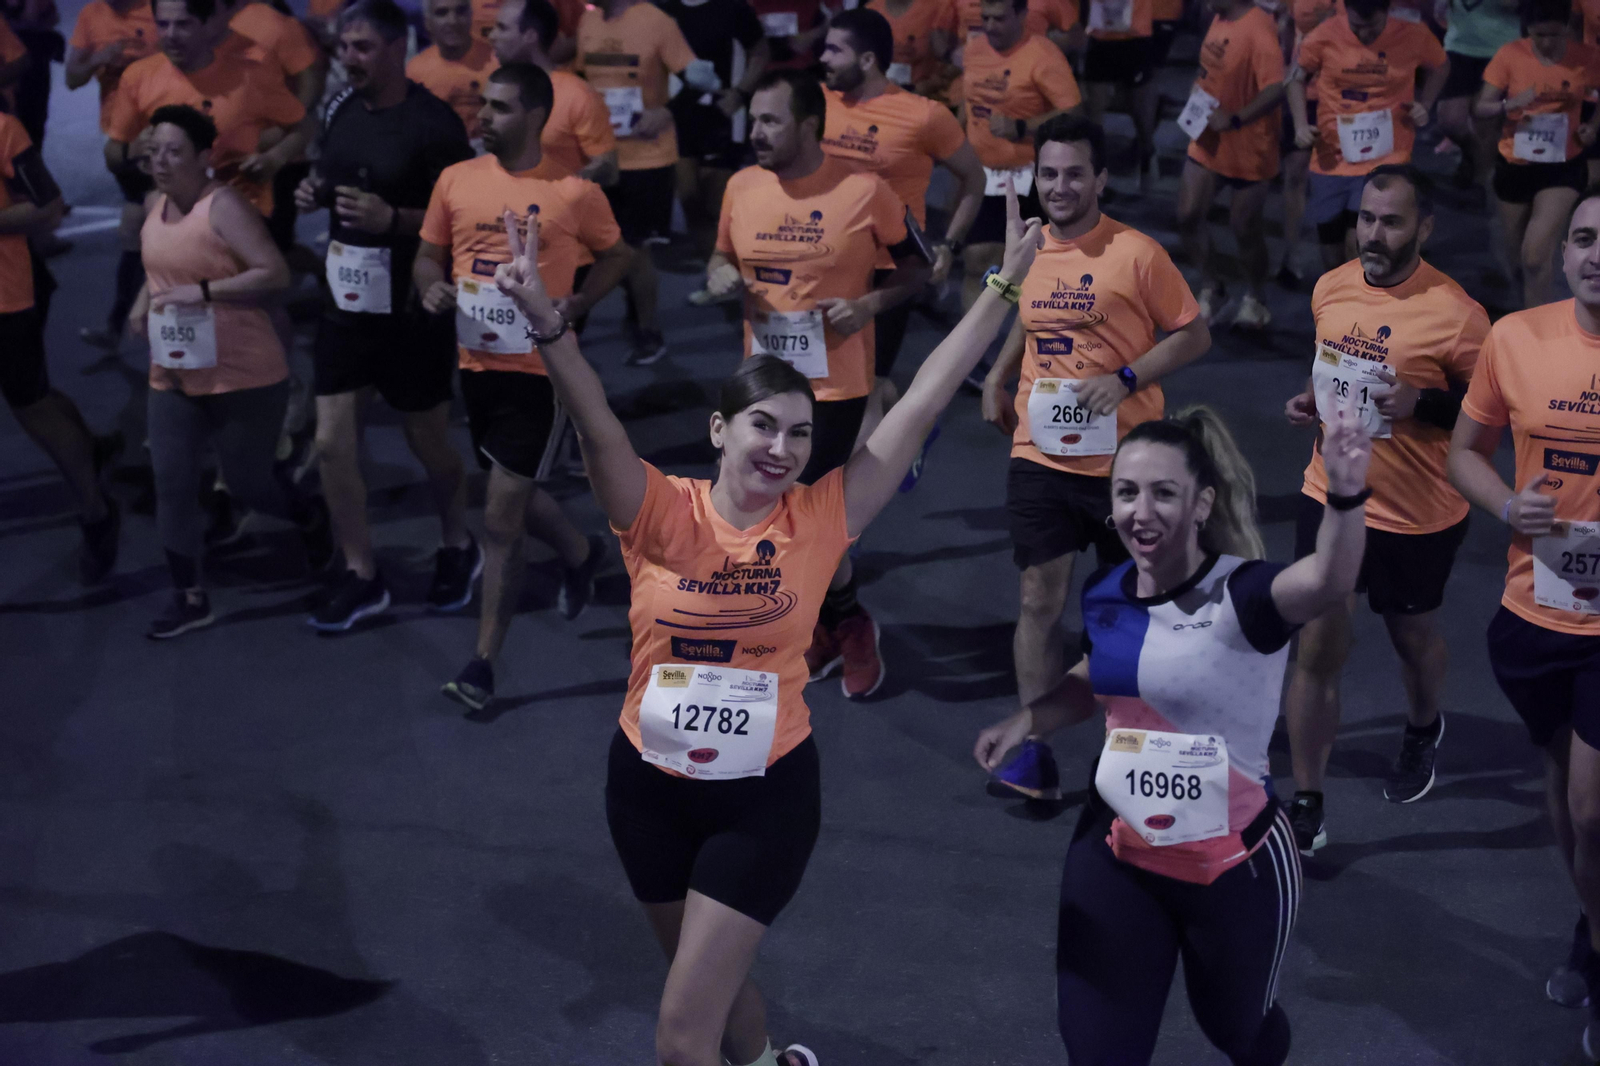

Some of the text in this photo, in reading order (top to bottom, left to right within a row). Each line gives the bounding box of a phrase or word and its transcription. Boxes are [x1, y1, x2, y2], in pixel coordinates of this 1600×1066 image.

[1031, 300, 1069, 310] SEVILLA
[1051, 291, 1096, 301] NOCTURNA
[471, 305, 515, 325] 11489
[763, 334, 809, 351] 10779
[1322, 338, 1360, 358] SEVILLA
[1342, 334, 1389, 356] NOCTURNA
[1333, 377, 1368, 404] 261
[711, 568, 781, 581] NOCTURNA
[677, 578, 742, 595] SEVILLA
[672, 703, 750, 735] 12782
[1125, 769, 1202, 800] 16968
